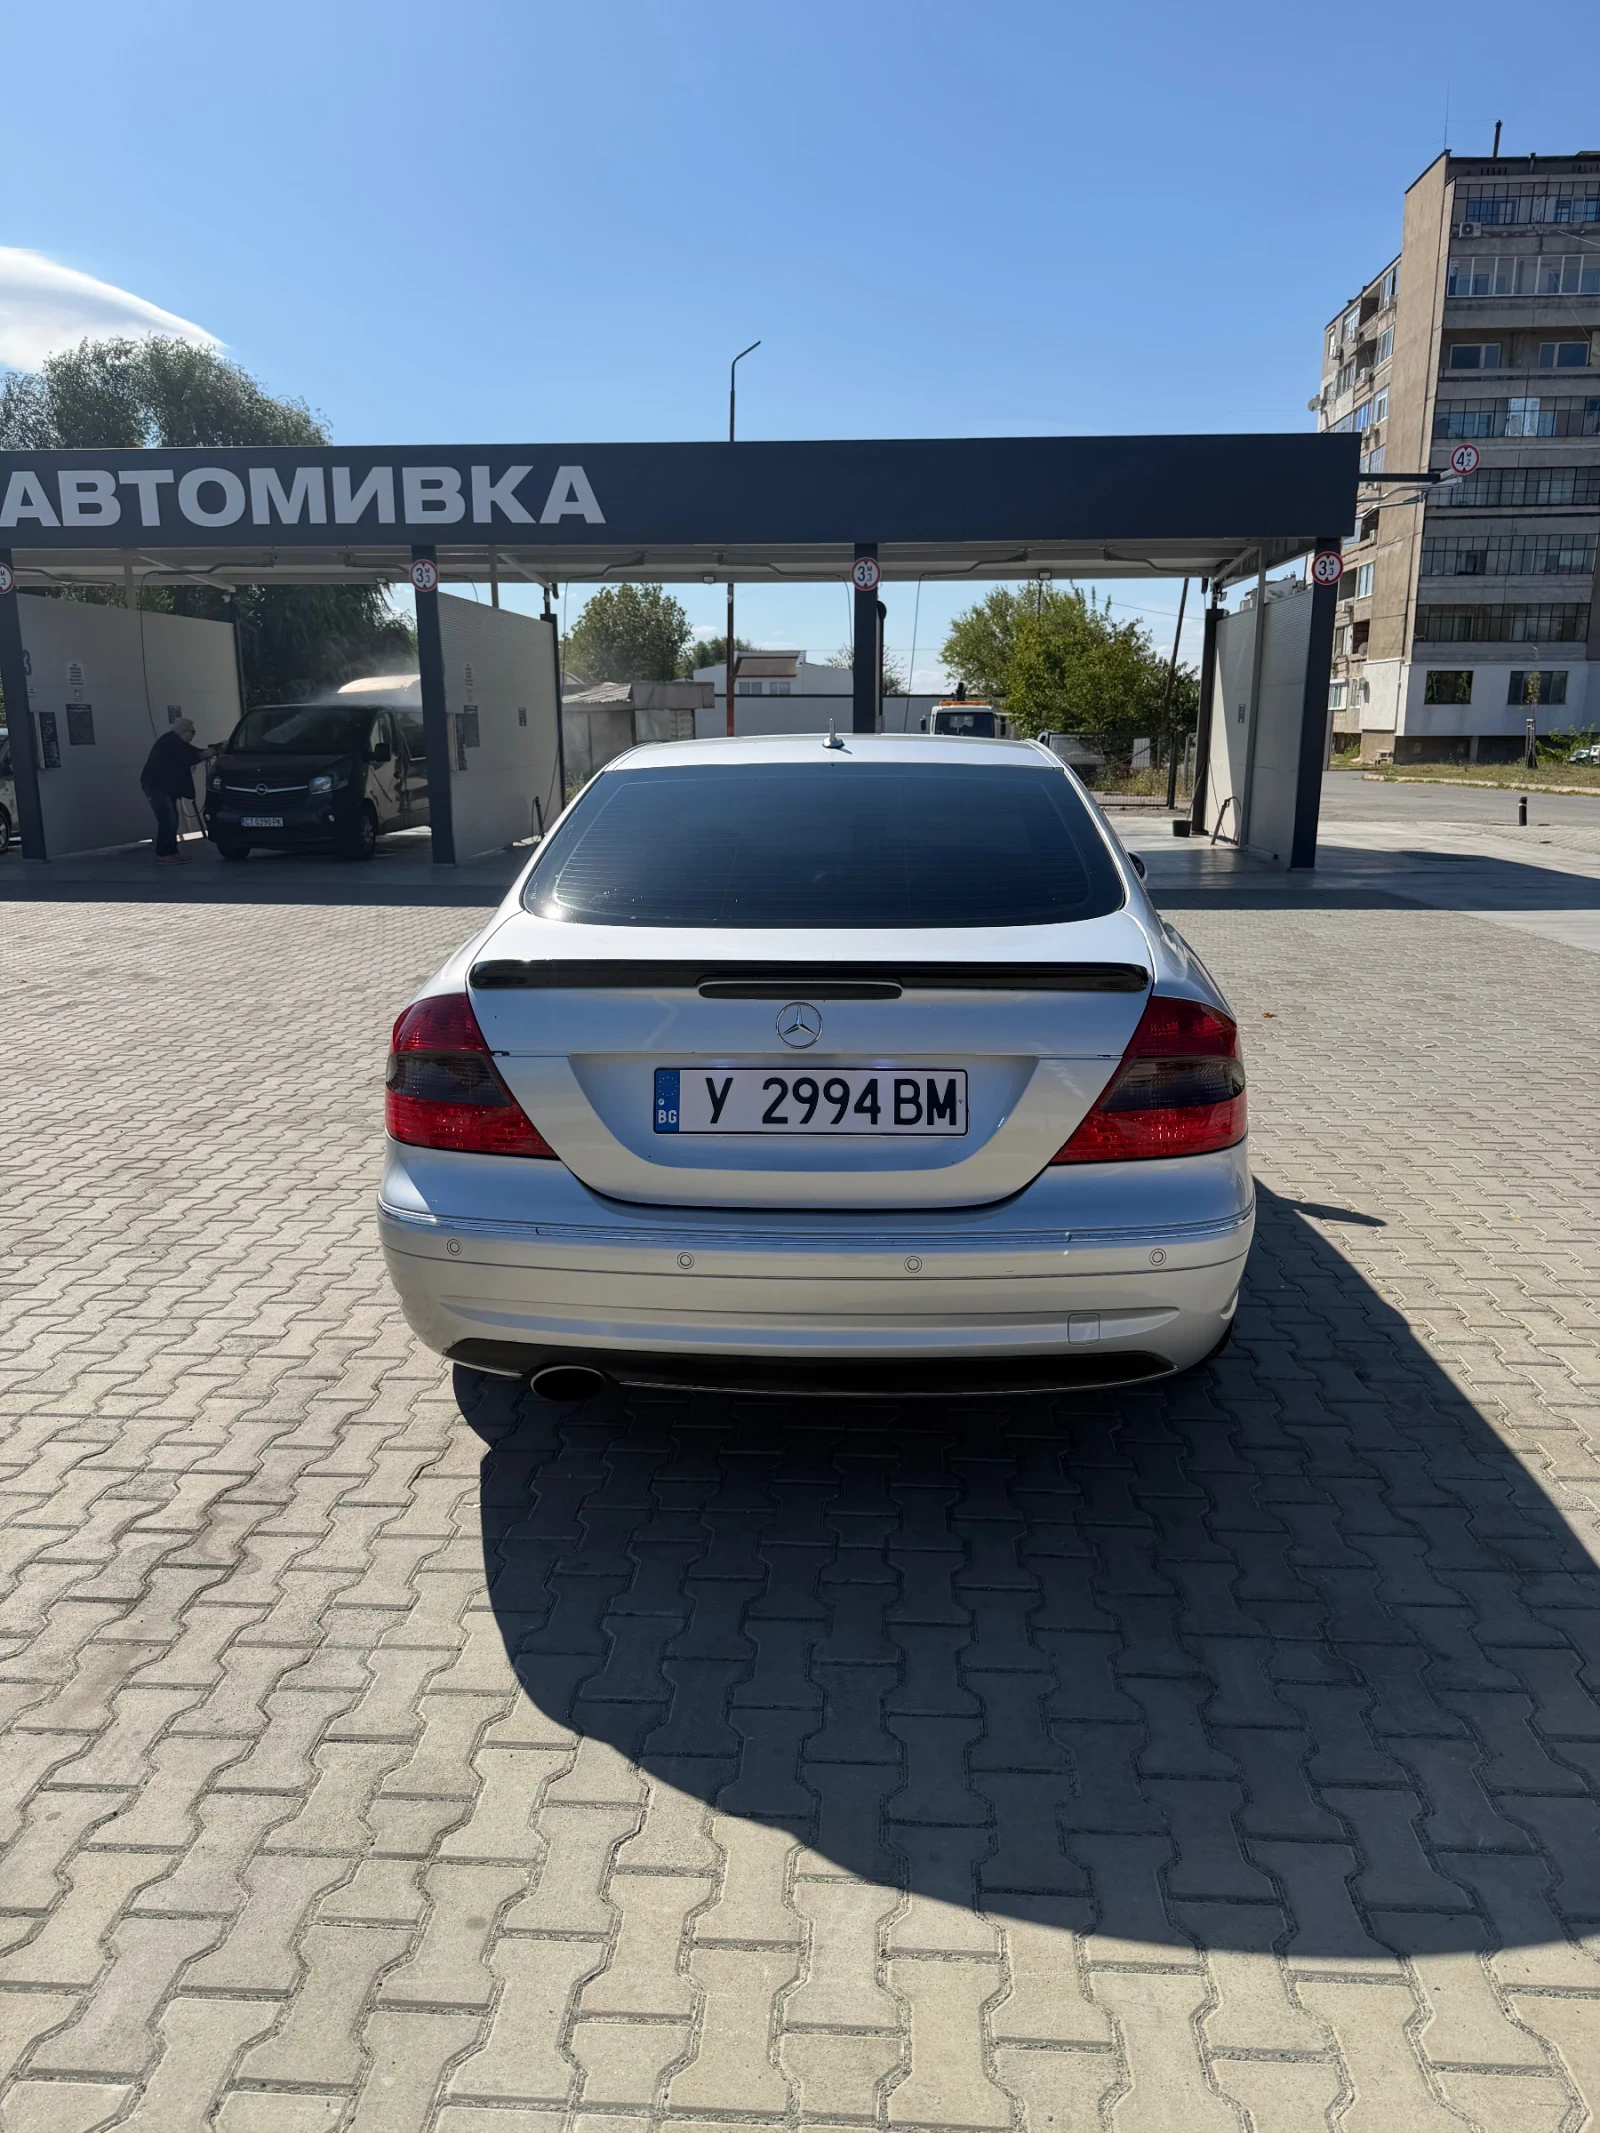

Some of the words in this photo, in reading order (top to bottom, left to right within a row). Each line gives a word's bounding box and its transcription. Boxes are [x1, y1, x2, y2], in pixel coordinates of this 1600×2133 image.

[1456, 451, 1465, 467] 4
[0, 465, 607, 527] АВТОМИВКА
[416, 567, 424, 583] 3
[857, 565, 866, 582] 3
[1319, 560, 1327, 576] 3
[761, 1077, 881, 1125] 2994
[893, 1078, 957, 1126] BM
[657, 1109, 677, 1124] BG
